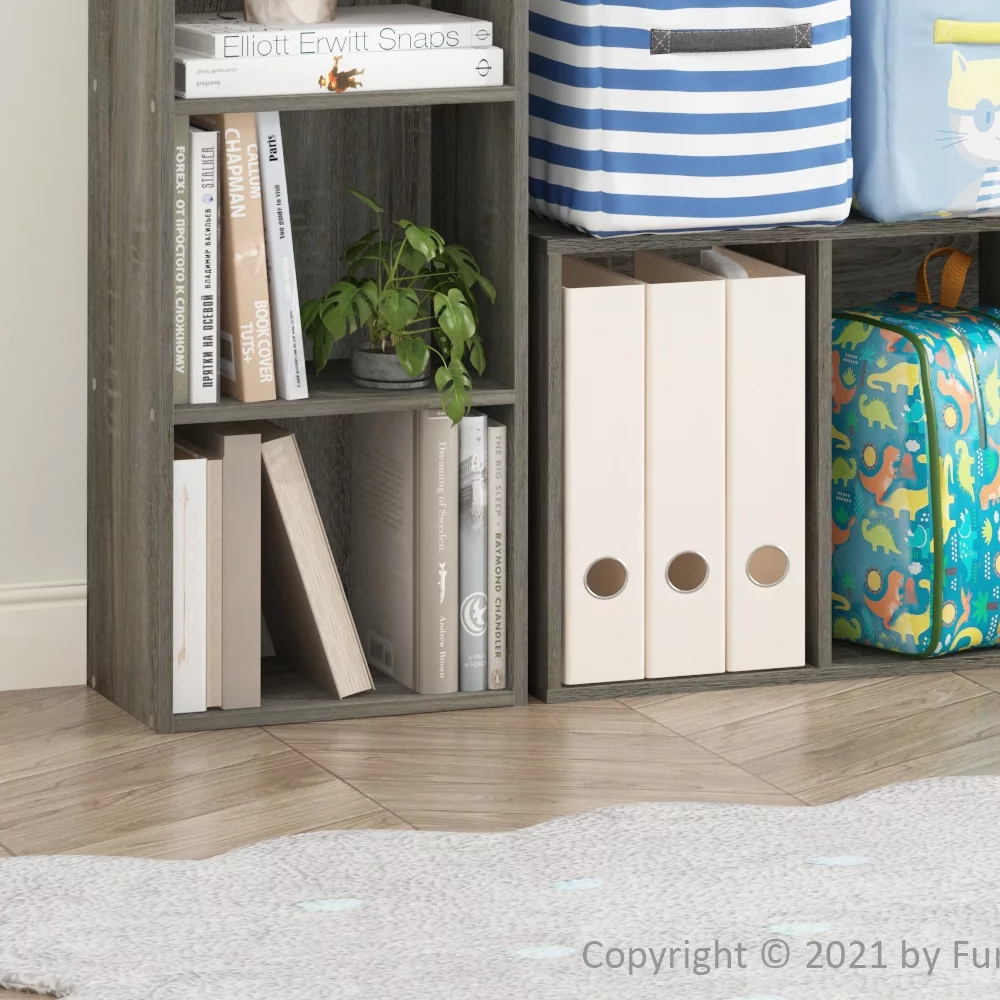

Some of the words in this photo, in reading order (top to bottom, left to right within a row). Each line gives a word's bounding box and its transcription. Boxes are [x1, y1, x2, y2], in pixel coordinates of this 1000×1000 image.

[223, 35, 290, 58] Elliott
[299, 30, 370, 54] Erwitt
[378, 27, 460, 51] Snaps
[267, 135, 278, 162] Paris
[175, 145, 186, 194] FOREX:
[225, 127, 246, 218] CHAPMAN
[246, 143, 261, 199] CALLUM
[175, 199, 186, 215] ОТ
[204, 208, 212, 246] ВАСИЛЬЕВ
[175, 218, 186, 284] ПРОСТОГО
[204, 250, 212, 289] ВЛАДИМИР
[175, 286, 186, 296] К
[201, 294, 214, 331] ОСЕВОЙ
[255, 300, 269, 338] BOOK
[175, 297, 186, 374] СЛОЖНОМУ
[202, 335, 214, 347] НА
[240, 322, 254, 364] TUTS+
[202, 351, 214, 388] ПРЯТКИ
[257, 339, 273, 383] COVER
[436, 442, 447, 494] Dreaming
[439, 497, 447, 509] of
[439, 510, 447, 551] Sweden
[439, 615, 447, 649] Andrew
[439, 651, 447, 679] Brown
